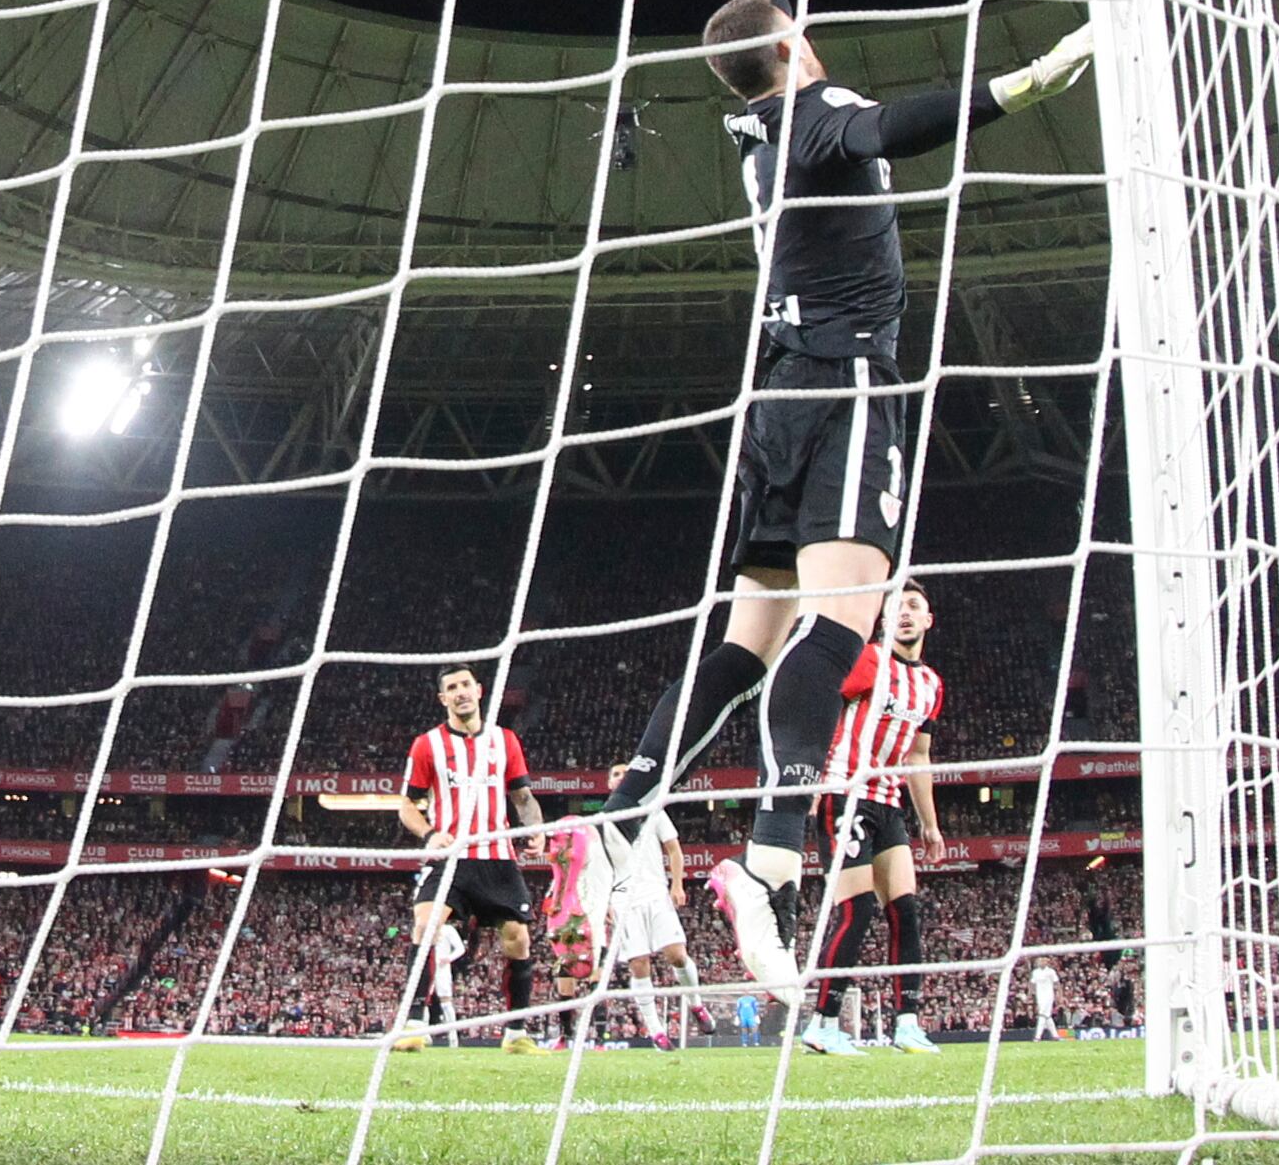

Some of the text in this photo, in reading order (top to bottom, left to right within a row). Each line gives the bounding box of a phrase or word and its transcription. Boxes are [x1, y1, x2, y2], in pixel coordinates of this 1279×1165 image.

[74, 773, 112, 784] CLB
[130, 774, 167, 785] CLUB
[185, 775, 221, 786] CLUB
[240, 775, 277, 786] CLUB
[296, 778, 393, 792] IMQ IMQ
[128, 848, 164, 858] CLUB
[182, 849, 219, 858] CLUB
[295, 856, 393, 868] IMQ IMQ
